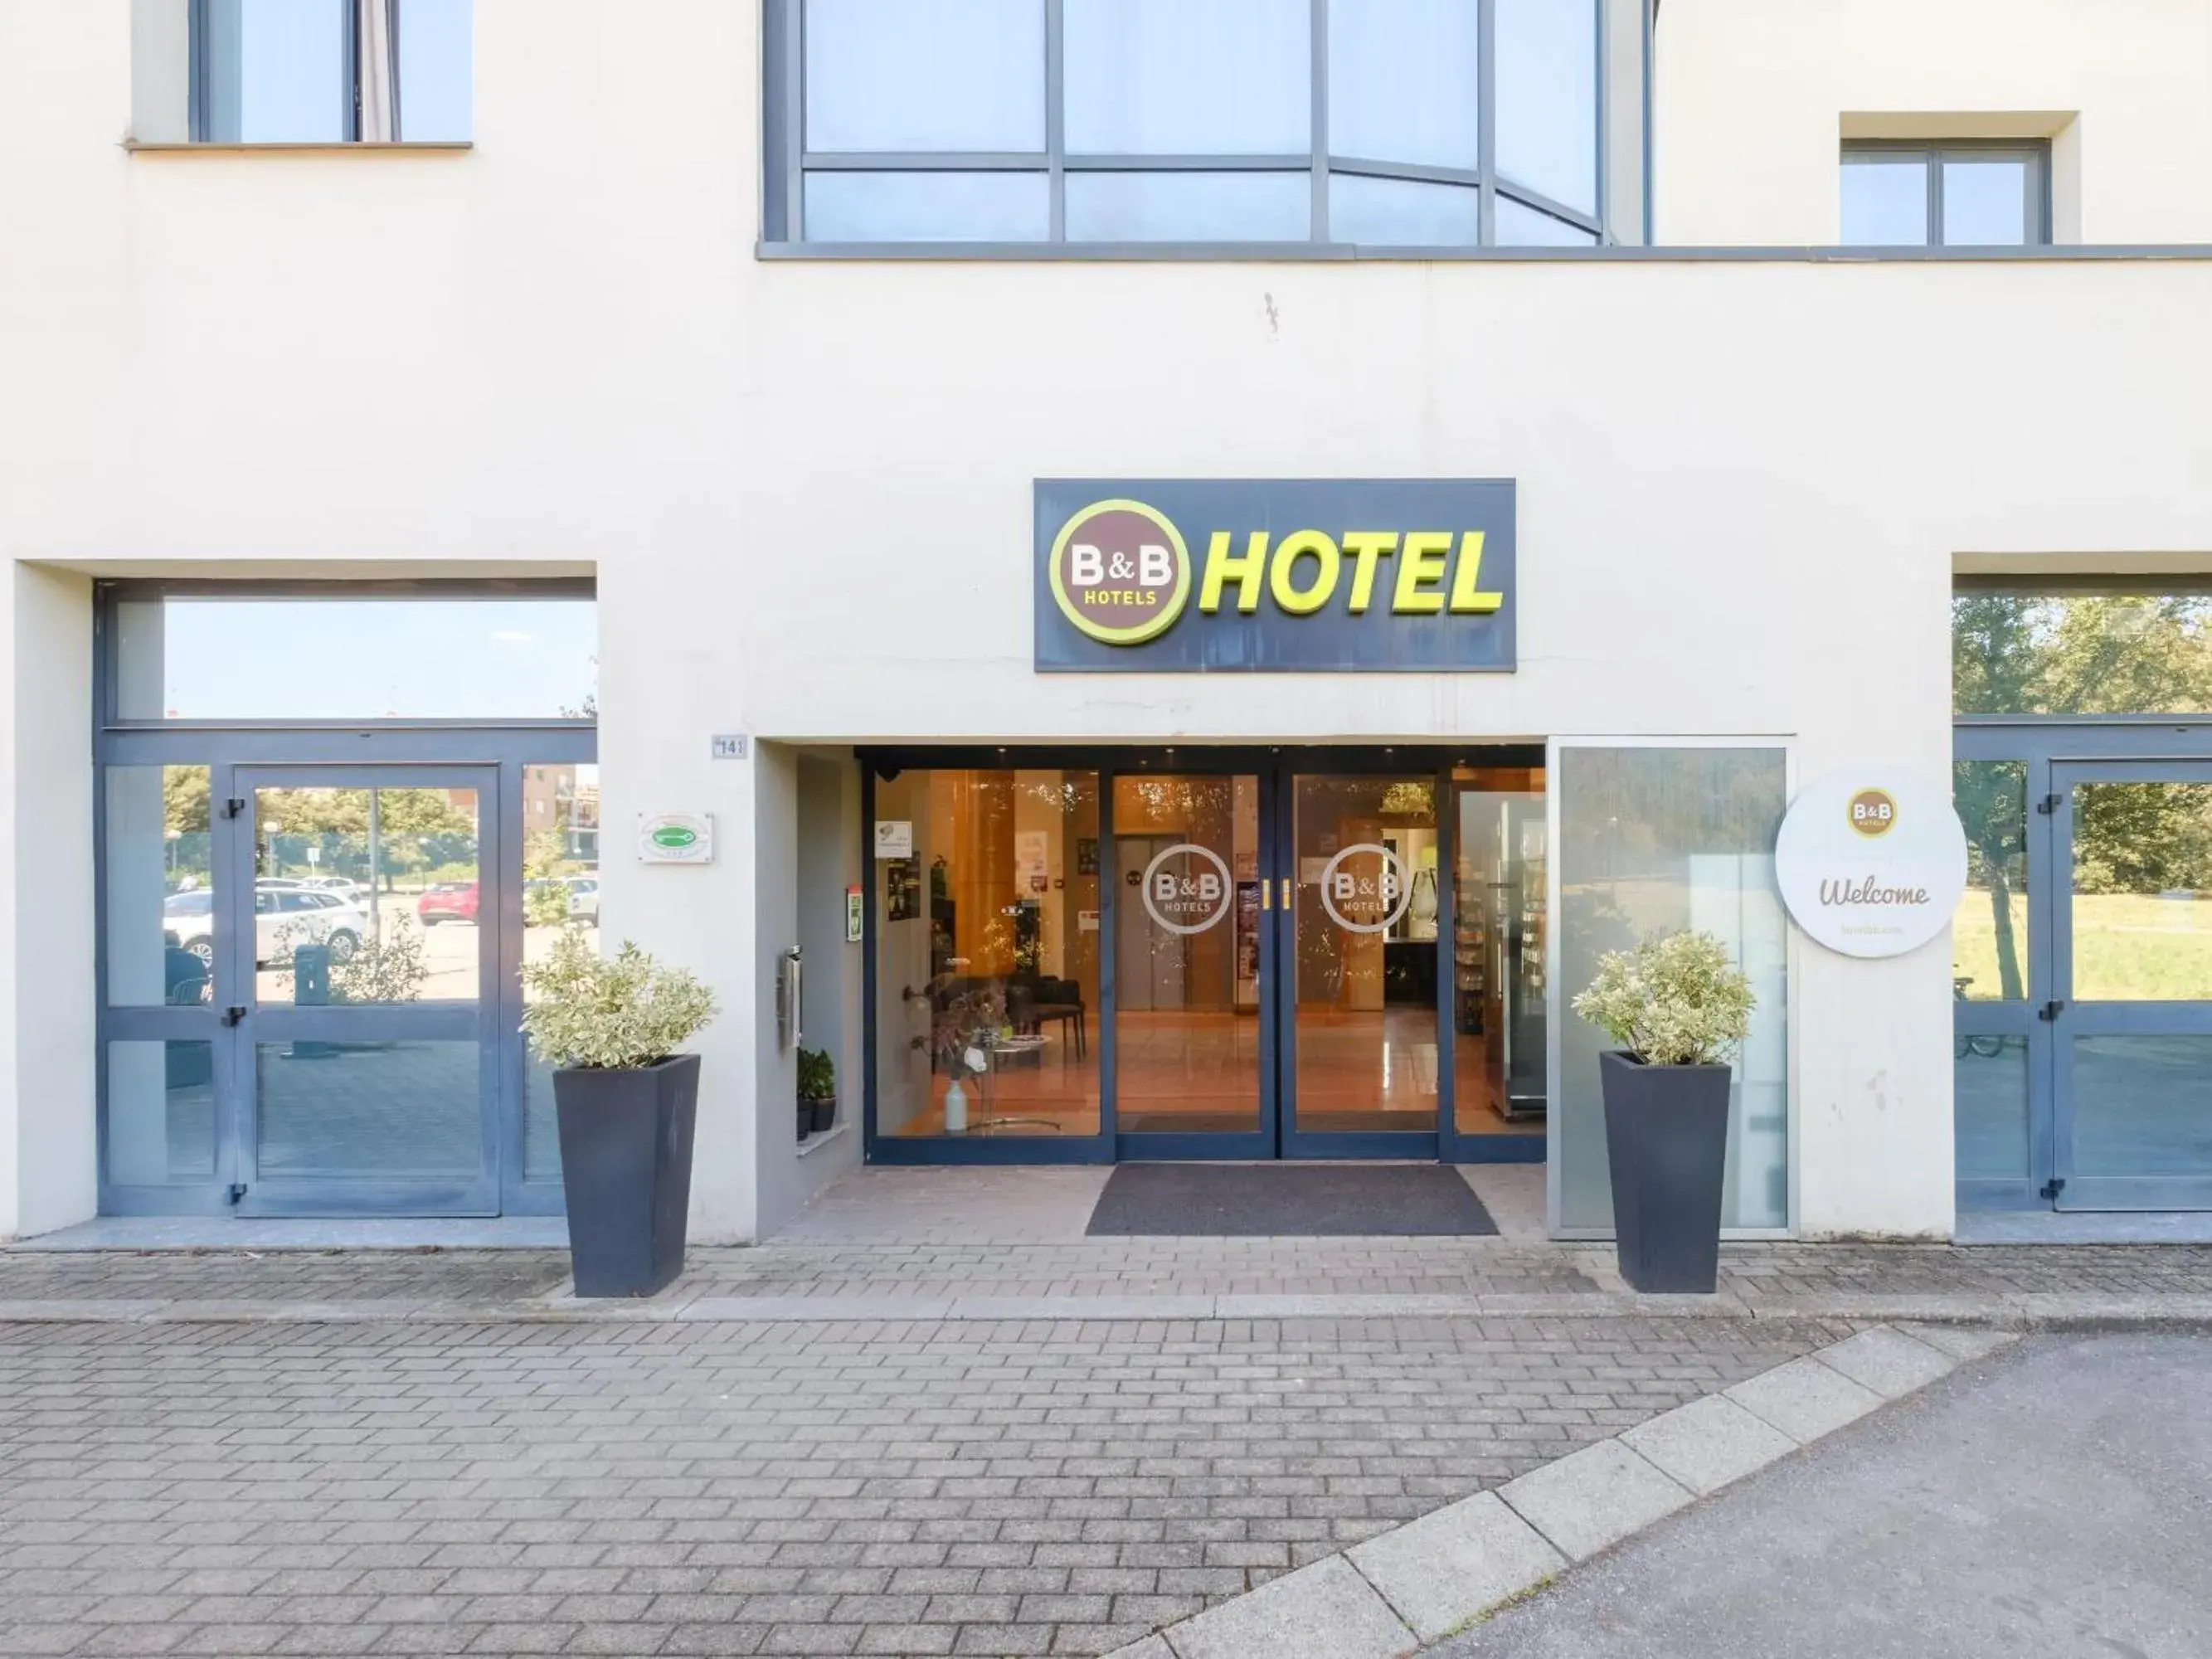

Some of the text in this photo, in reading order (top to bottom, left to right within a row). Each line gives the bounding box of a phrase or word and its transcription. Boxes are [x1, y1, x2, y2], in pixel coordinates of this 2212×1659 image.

[1071, 544, 1172, 586] B&B
[1198, 528, 1504, 615] HOTEL
[1084, 590, 1156, 605] HOTELS
[1854, 802, 1892, 820] B&B
[1156, 873, 1221, 900] B&B
[1335, 873, 1399, 899] B&B
[1820, 874, 1931, 906] Welcome
[1164, 902, 1211, 912] HOTELS
